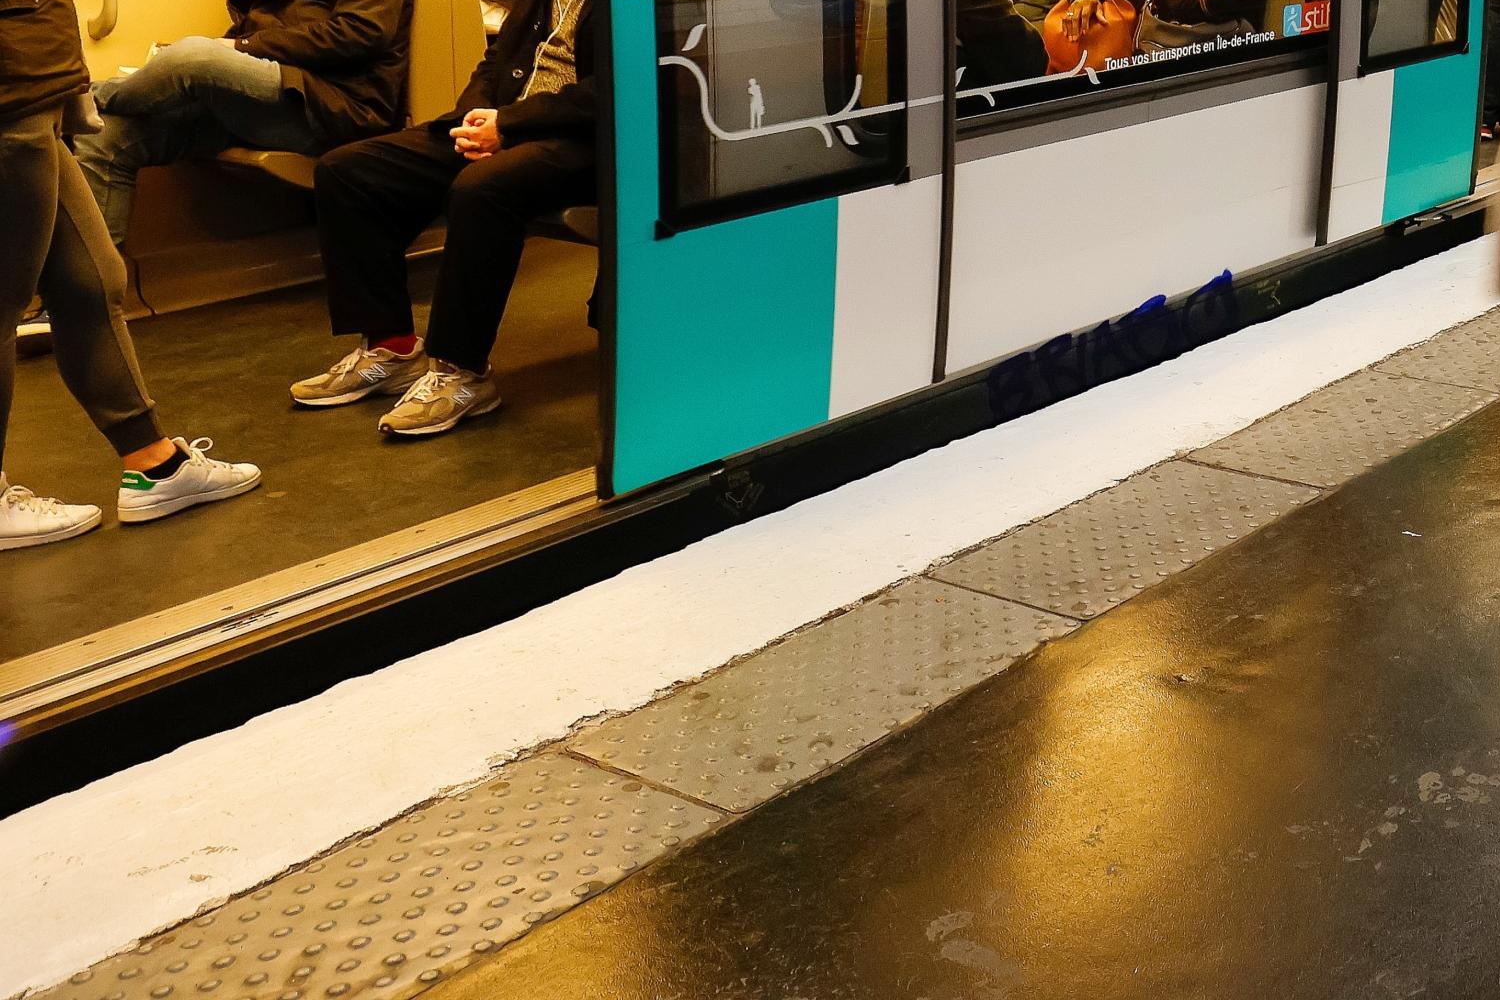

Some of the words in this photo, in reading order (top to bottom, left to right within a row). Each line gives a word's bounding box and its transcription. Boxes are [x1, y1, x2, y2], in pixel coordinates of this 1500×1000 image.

[1104, 52, 1129, 71] Tous
[1131, 53, 1150, 67] vos
[1151, 43, 1201, 63] transports
[1203, 40, 1215, 53] en
[1216, 29, 1276, 52] Île-de-France
